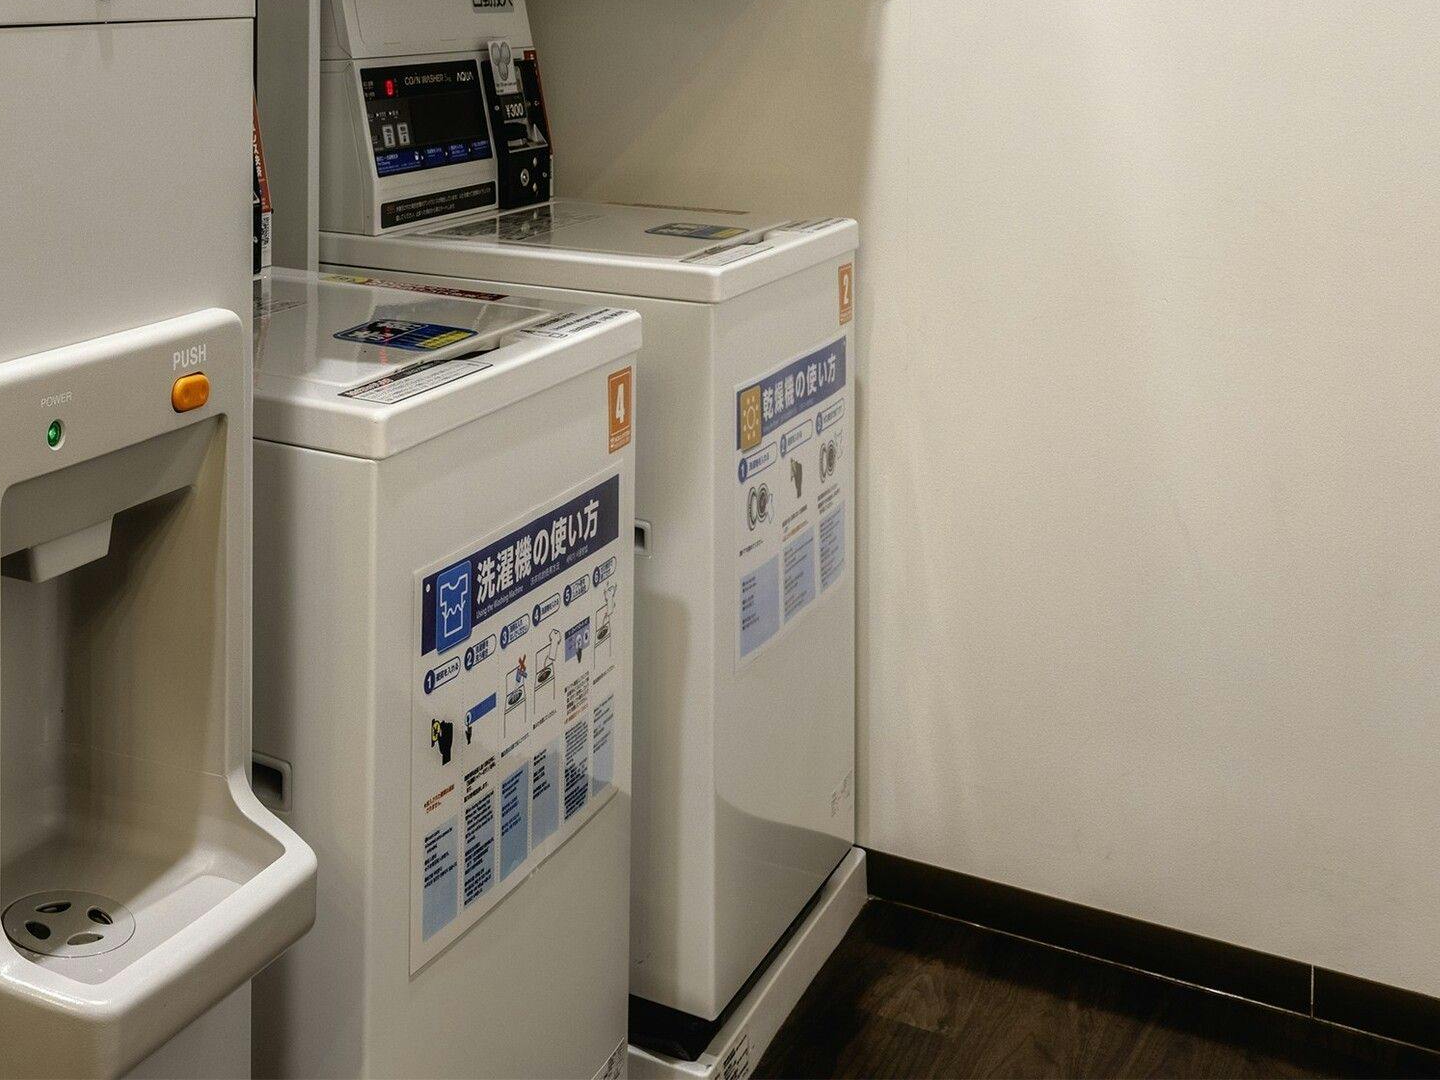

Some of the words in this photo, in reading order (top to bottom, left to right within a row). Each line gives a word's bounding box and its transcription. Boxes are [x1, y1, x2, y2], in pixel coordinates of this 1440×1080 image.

[456, 71, 474, 82] AQUA
[842, 275, 850, 305] 2
[172, 344, 207, 370] PUSH
[40, 391, 73, 408] POWER
[762, 353, 836, 422] 乾燥機の使い方
[616, 383, 625, 423] 4
[477, 499, 599, 605] 洗濯機の使い方
